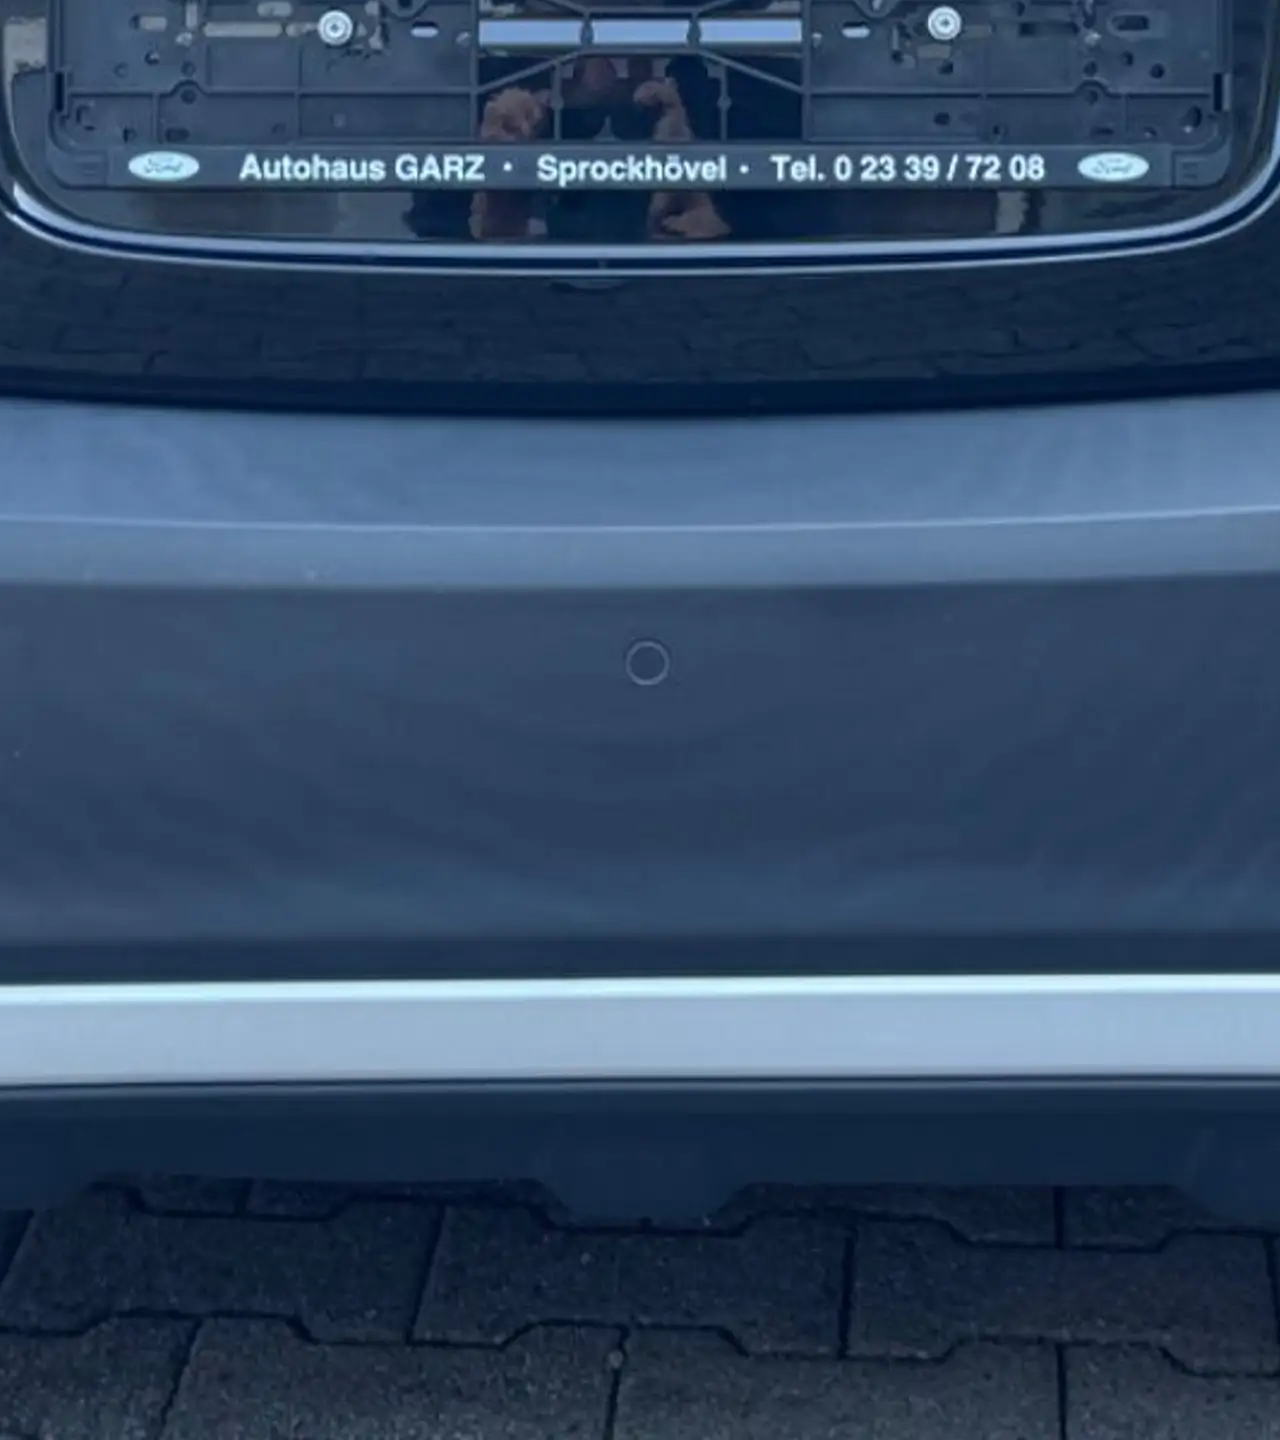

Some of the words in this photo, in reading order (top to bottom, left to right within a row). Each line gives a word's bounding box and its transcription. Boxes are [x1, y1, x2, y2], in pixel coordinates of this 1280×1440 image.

[239, 153, 386, 181] Autohaus
[394, 153, 485, 181] GARZ
[537, 153, 727, 188] Sprockhövel
[770, 154, 825, 181] Tel.
[834, 154, 853, 181] 0
[860, 154, 897, 181] 23
[903, 154, 940, 181] 39
[965, 154, 1001, 181] 72
[1009, 154, 1045, 181] 08
